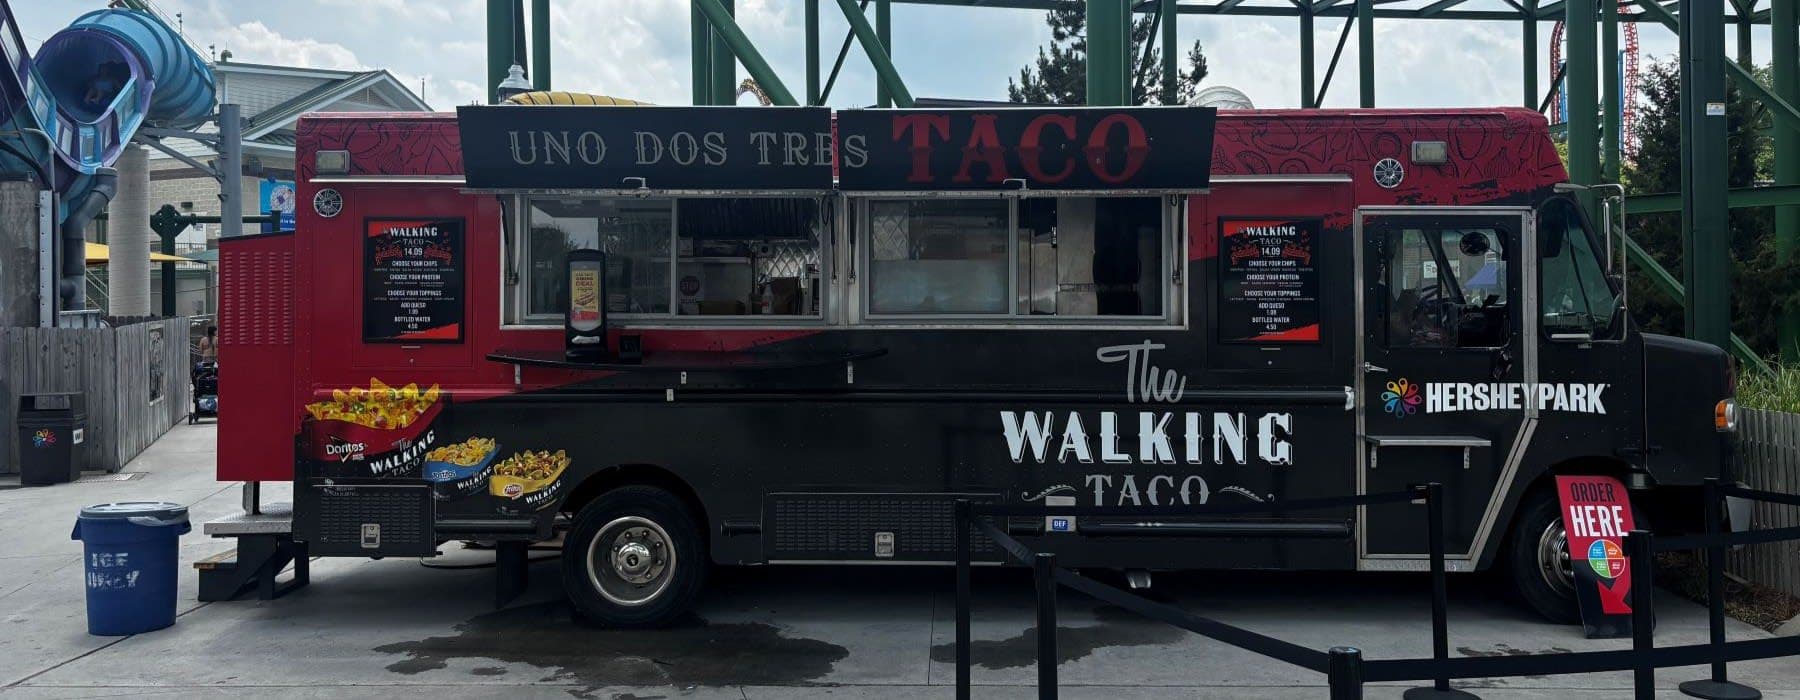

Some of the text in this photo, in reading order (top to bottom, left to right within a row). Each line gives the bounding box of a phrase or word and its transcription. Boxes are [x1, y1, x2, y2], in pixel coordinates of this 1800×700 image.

[509, 113, 1150, 184] UNO DOS TRES TACO
[390, 226, 438, 237] WALKING
[1246, 225, 1296, 236] WALKING
[1259, 237, 1281, 245] TACO
[403, 238, 424, 246] TACO
[404, 247, 423, 256] 14.09
[1261, 246, 1281, 256] 14.09
[1096, 340, 1187, 403] The
[1426, 382, 1607, 414] HERSHEYPARK
[326, 442, 366, 455] Doritos
[1000, 410, 1293, 465] WALKING
[370, 430, 436, 475] WALKING
[391, 458, 420, 477] TACO
[457, 465, 492, 490] WALKING
[525, 480, 562, 504] WALKING
[1085, 474, 1210, 507] TACO
[1571, 482, 1616, 502] ORDER
[1569, 505, 1629, 537] HERE
